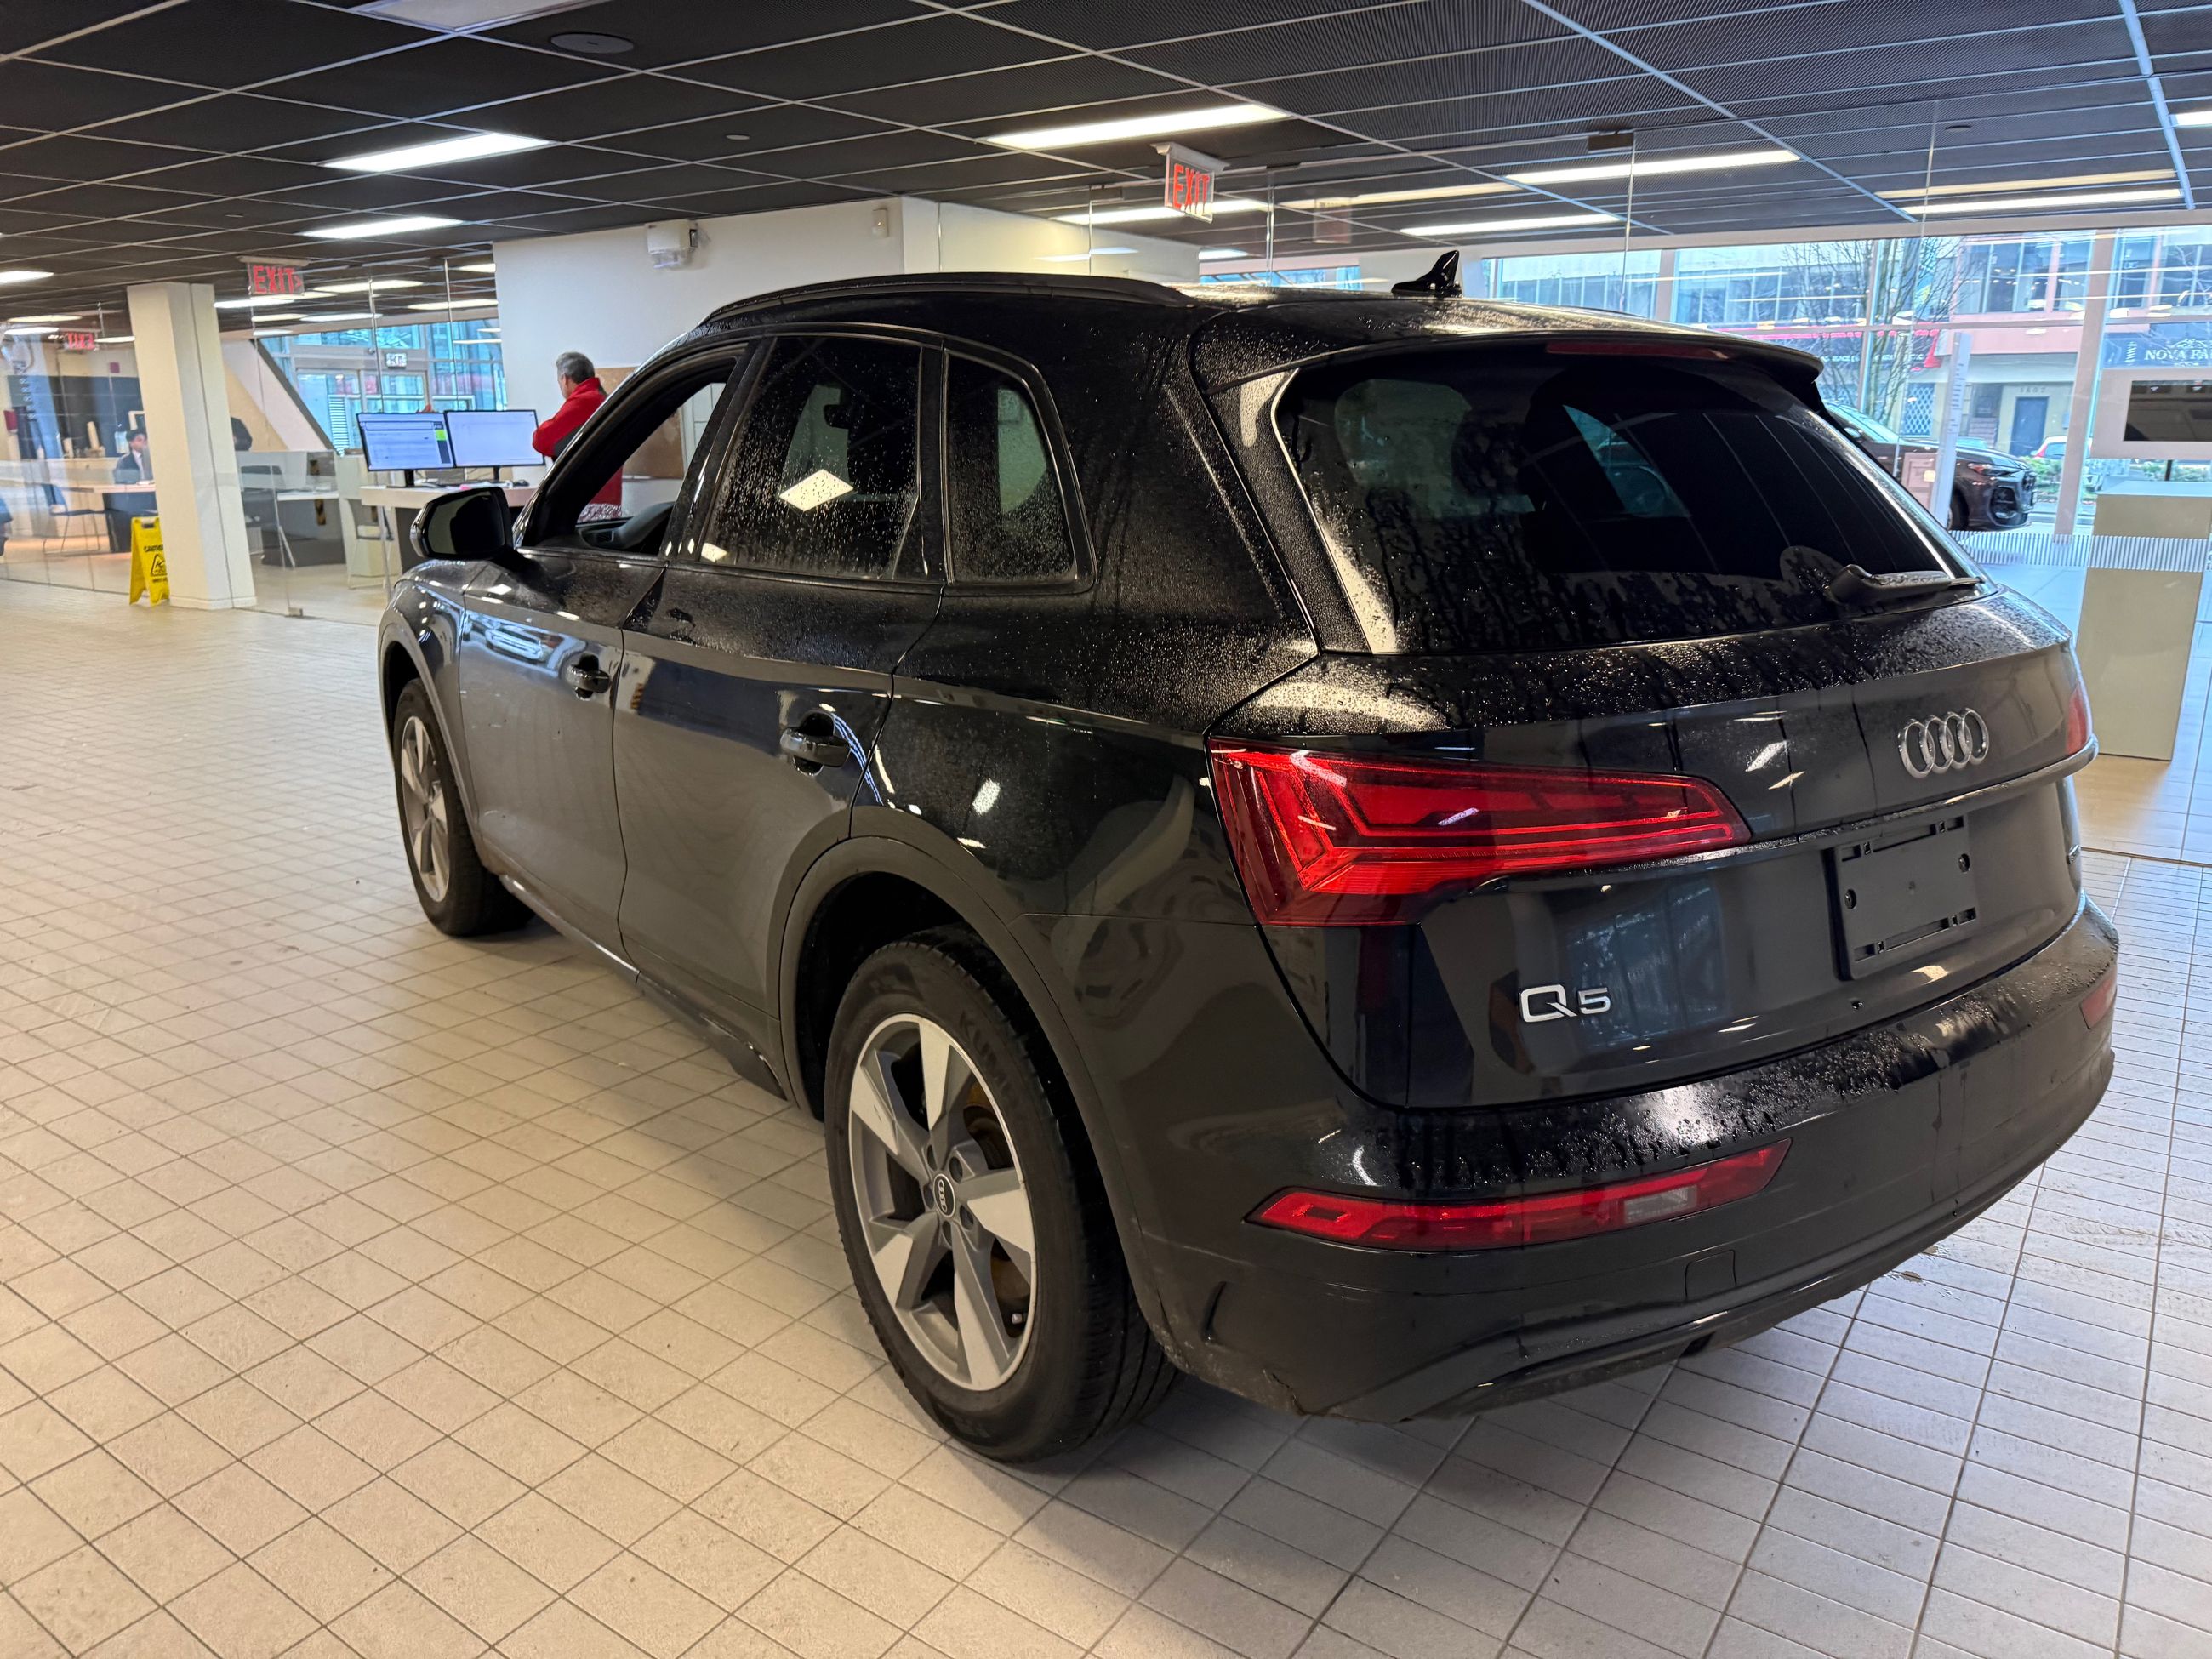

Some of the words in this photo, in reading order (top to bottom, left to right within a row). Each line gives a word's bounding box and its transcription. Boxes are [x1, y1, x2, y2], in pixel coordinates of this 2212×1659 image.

[1172, 163, 1211, 215] EXIT
[253, 265, 294, 294] EXIT
[1519, 984, 1611, 1023] Q5
